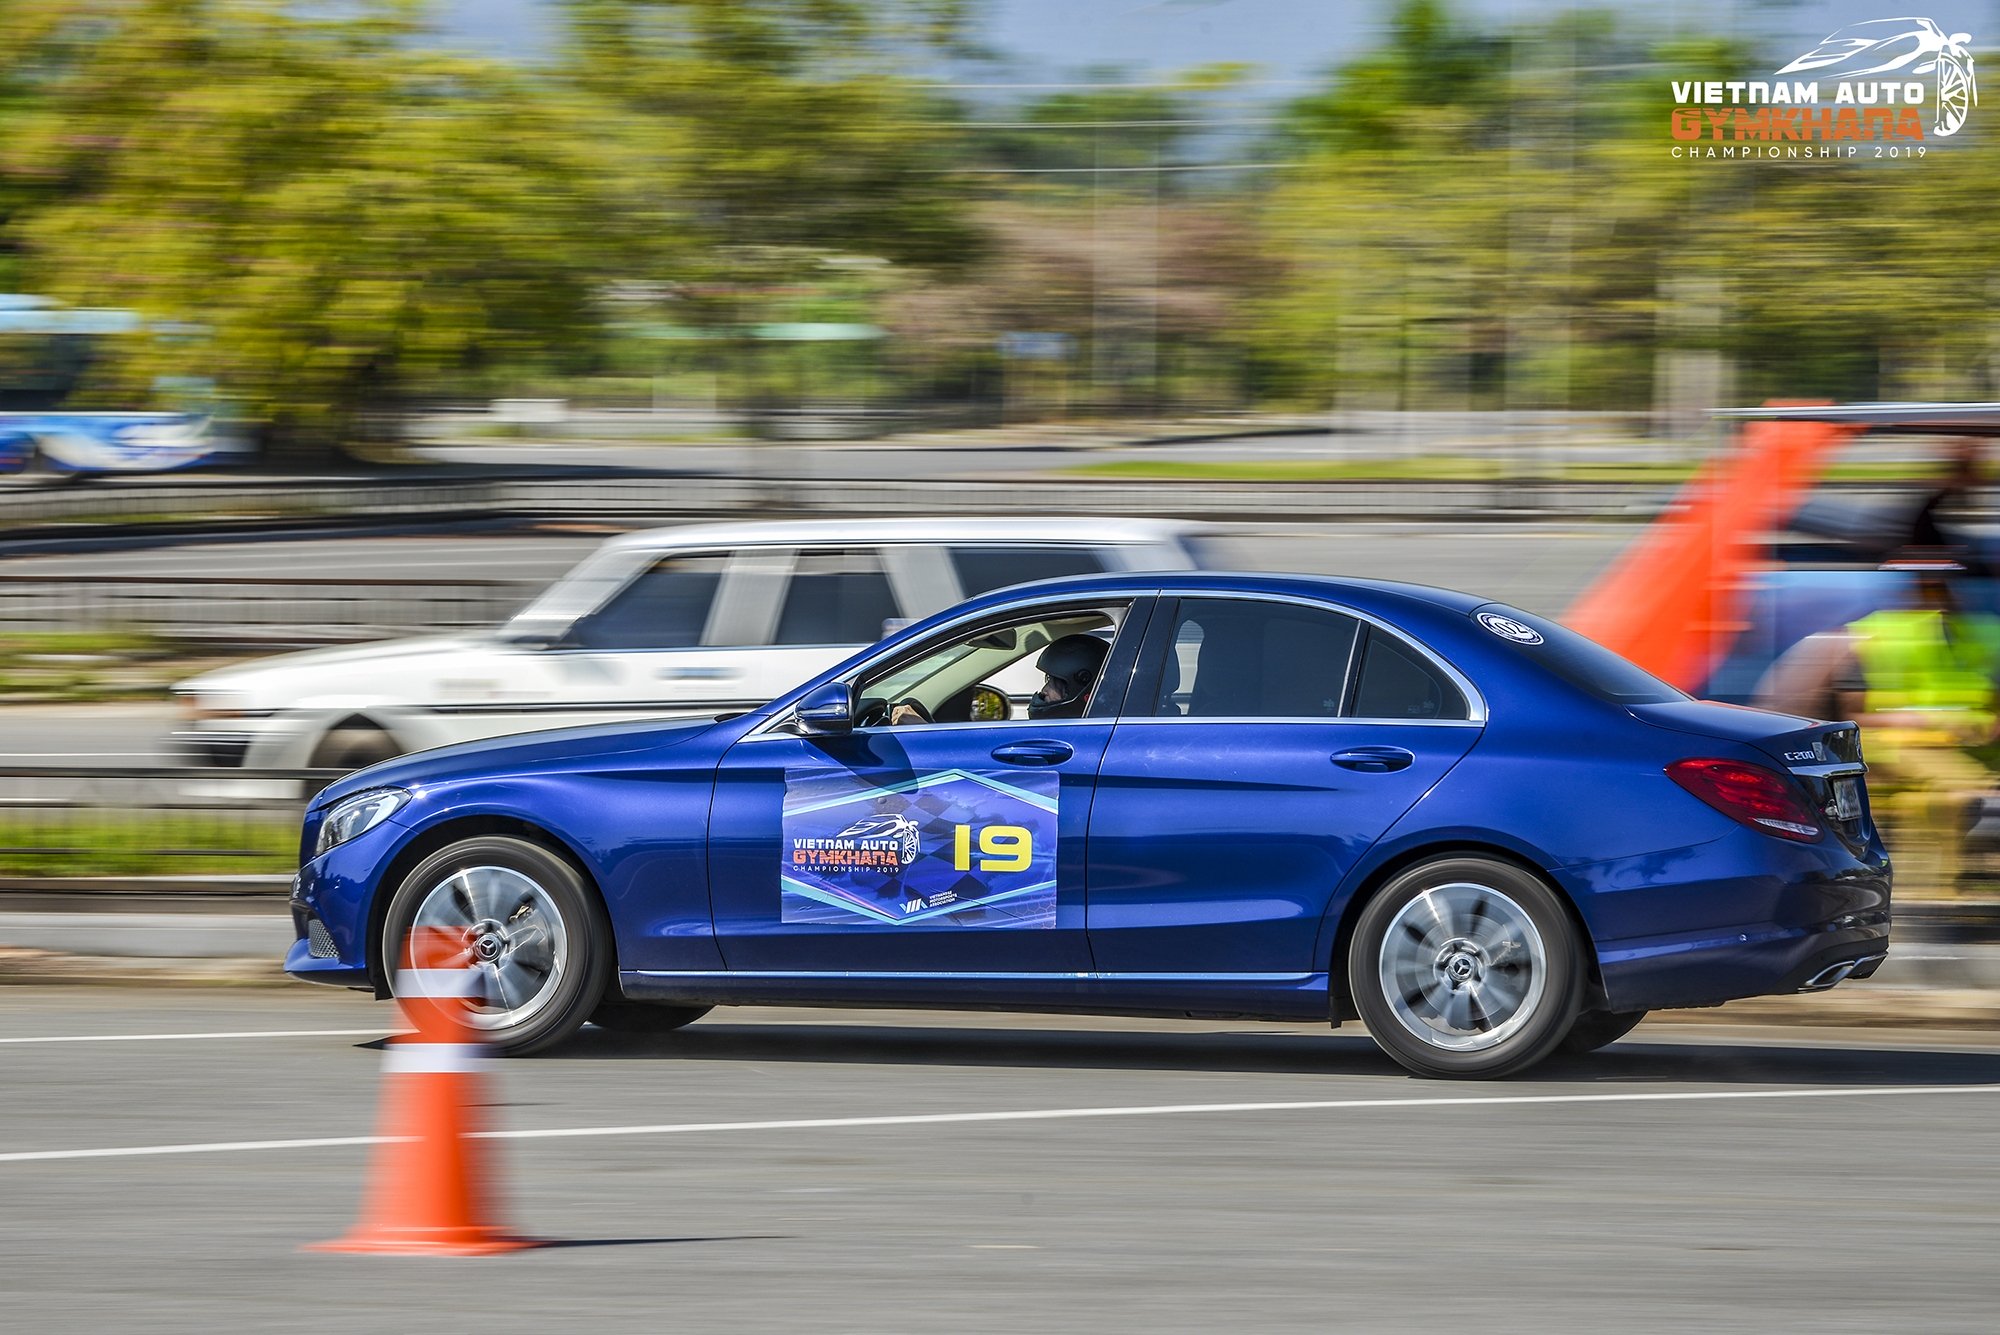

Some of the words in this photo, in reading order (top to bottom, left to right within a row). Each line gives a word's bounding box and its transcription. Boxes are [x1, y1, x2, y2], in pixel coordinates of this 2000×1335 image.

[793, 838, 854, 850] VIETNAM
[860, 840, 899, 850] AUTO
[954, 824, 1032, 872] 19
[793, 849, 898, 865] GYMKHANA
[793, 865, 871, 873] CHAMPIONSHIP
